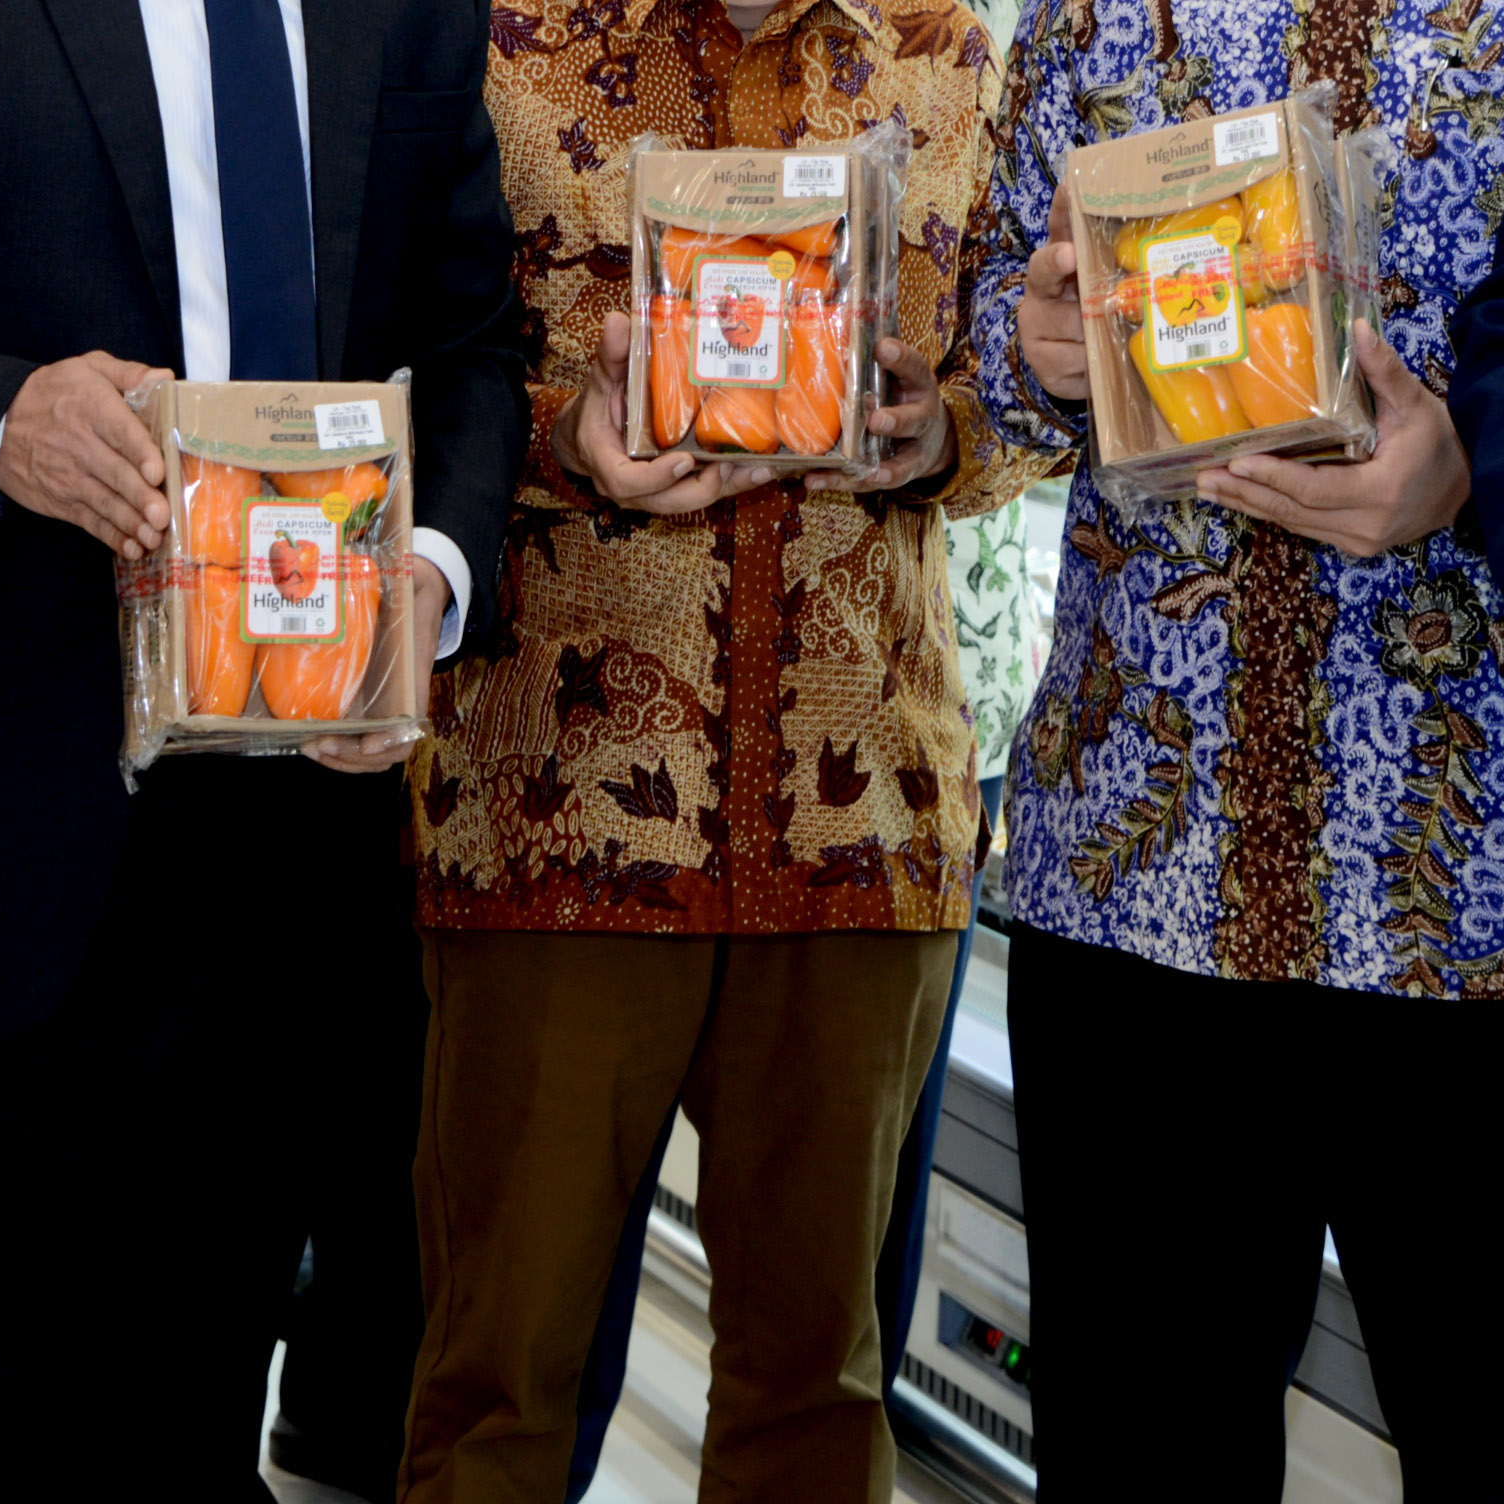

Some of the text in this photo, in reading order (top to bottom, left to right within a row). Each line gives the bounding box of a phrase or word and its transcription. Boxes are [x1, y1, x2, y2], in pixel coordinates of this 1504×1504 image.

[1146, 138, 1209, 164] Highland
[714, 171, 776, 187] Highland
[1173, 247, 1225, 262] CAPSICUM
[727, 276, 777, 285] CAPSICUM
[1158, 317, 1227, 342] Highland
[702, 341, 769, 359] Highland
[255, 405, 315, 423] Highlan
[253, 593, 325, 612] Highland
